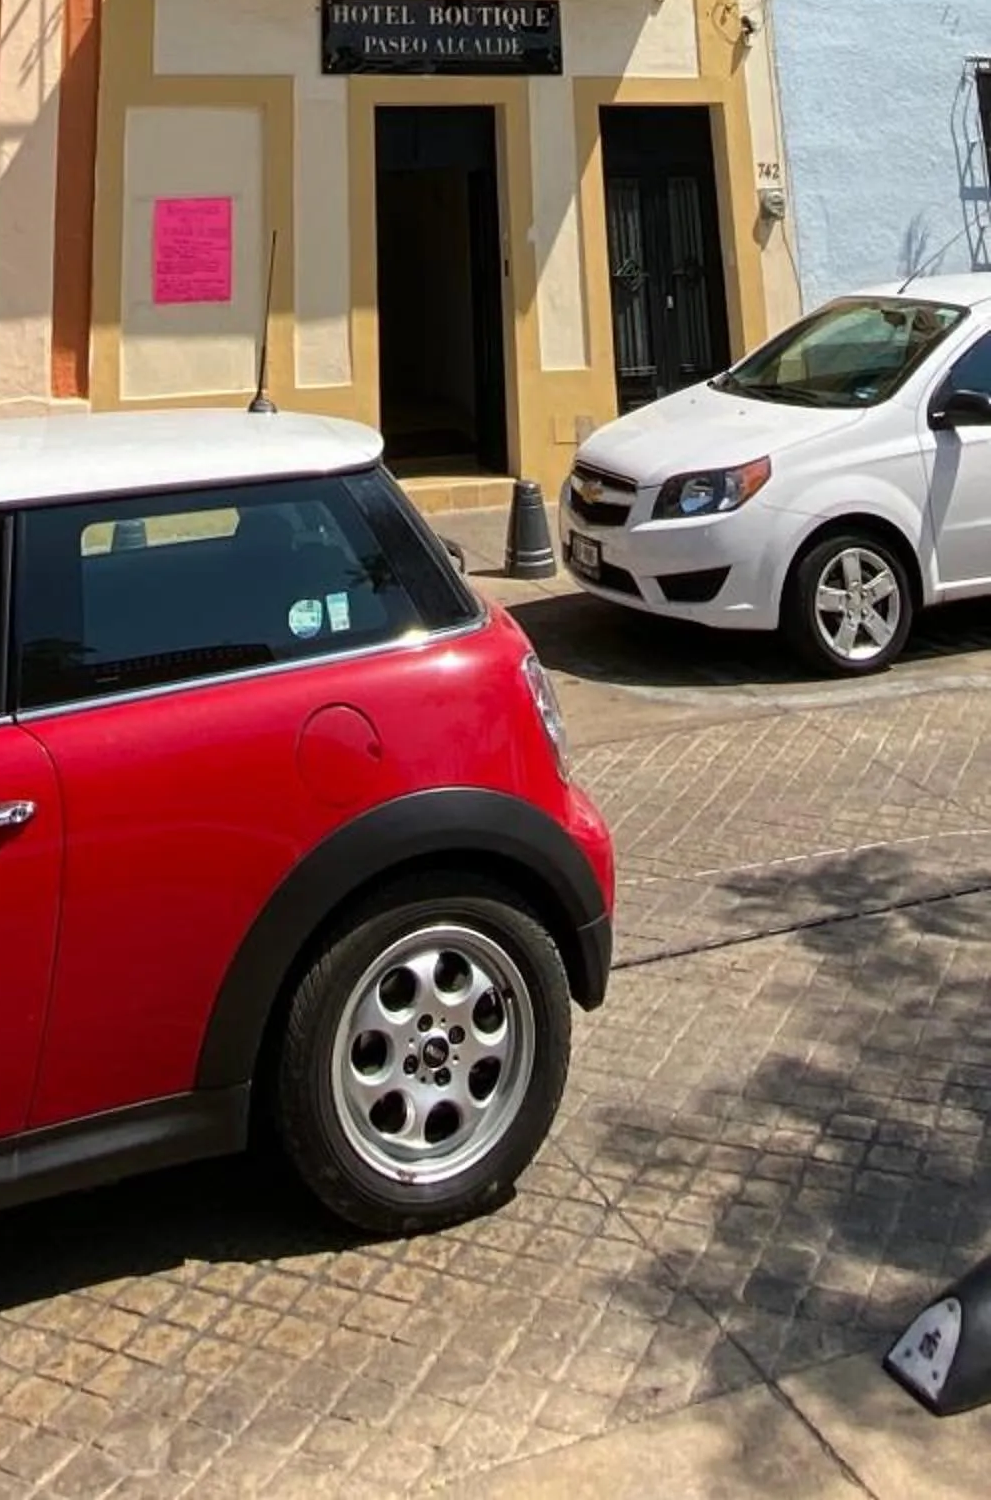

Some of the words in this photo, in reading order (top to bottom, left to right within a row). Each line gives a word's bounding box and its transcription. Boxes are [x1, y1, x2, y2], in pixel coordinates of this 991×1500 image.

[333, 3, 416, 25] HOTEL
[429, 6, 551, 32] BOUTIQUE
[364, 35, 428, 55] PASEO
[431, 37, 525, 56] ALCALDE
[757, 162, 780, 180] 742
